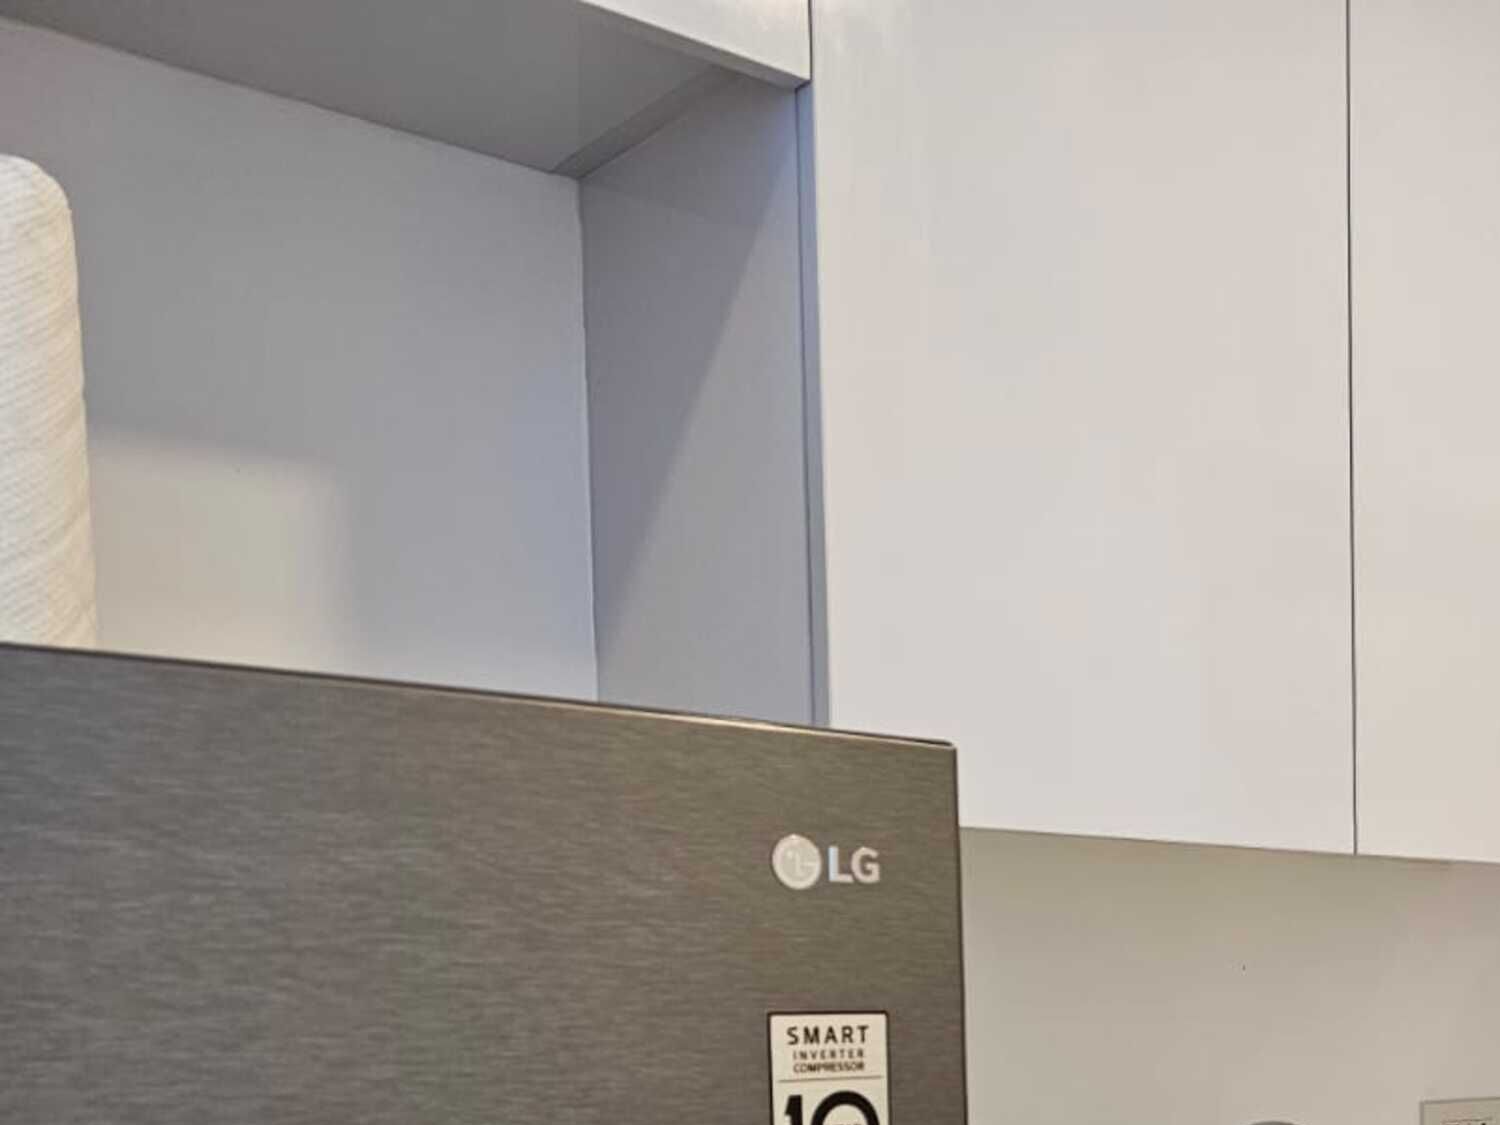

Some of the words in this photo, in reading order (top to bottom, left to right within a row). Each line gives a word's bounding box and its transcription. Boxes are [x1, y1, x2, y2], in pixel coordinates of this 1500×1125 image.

[828, 846, 880, 884] LG
[786, 1025, 869, 1045] SMART
[793, 1048, 864, 1061] INVERTER
[793, 1061, 864, 1073] COMPRESSOR
